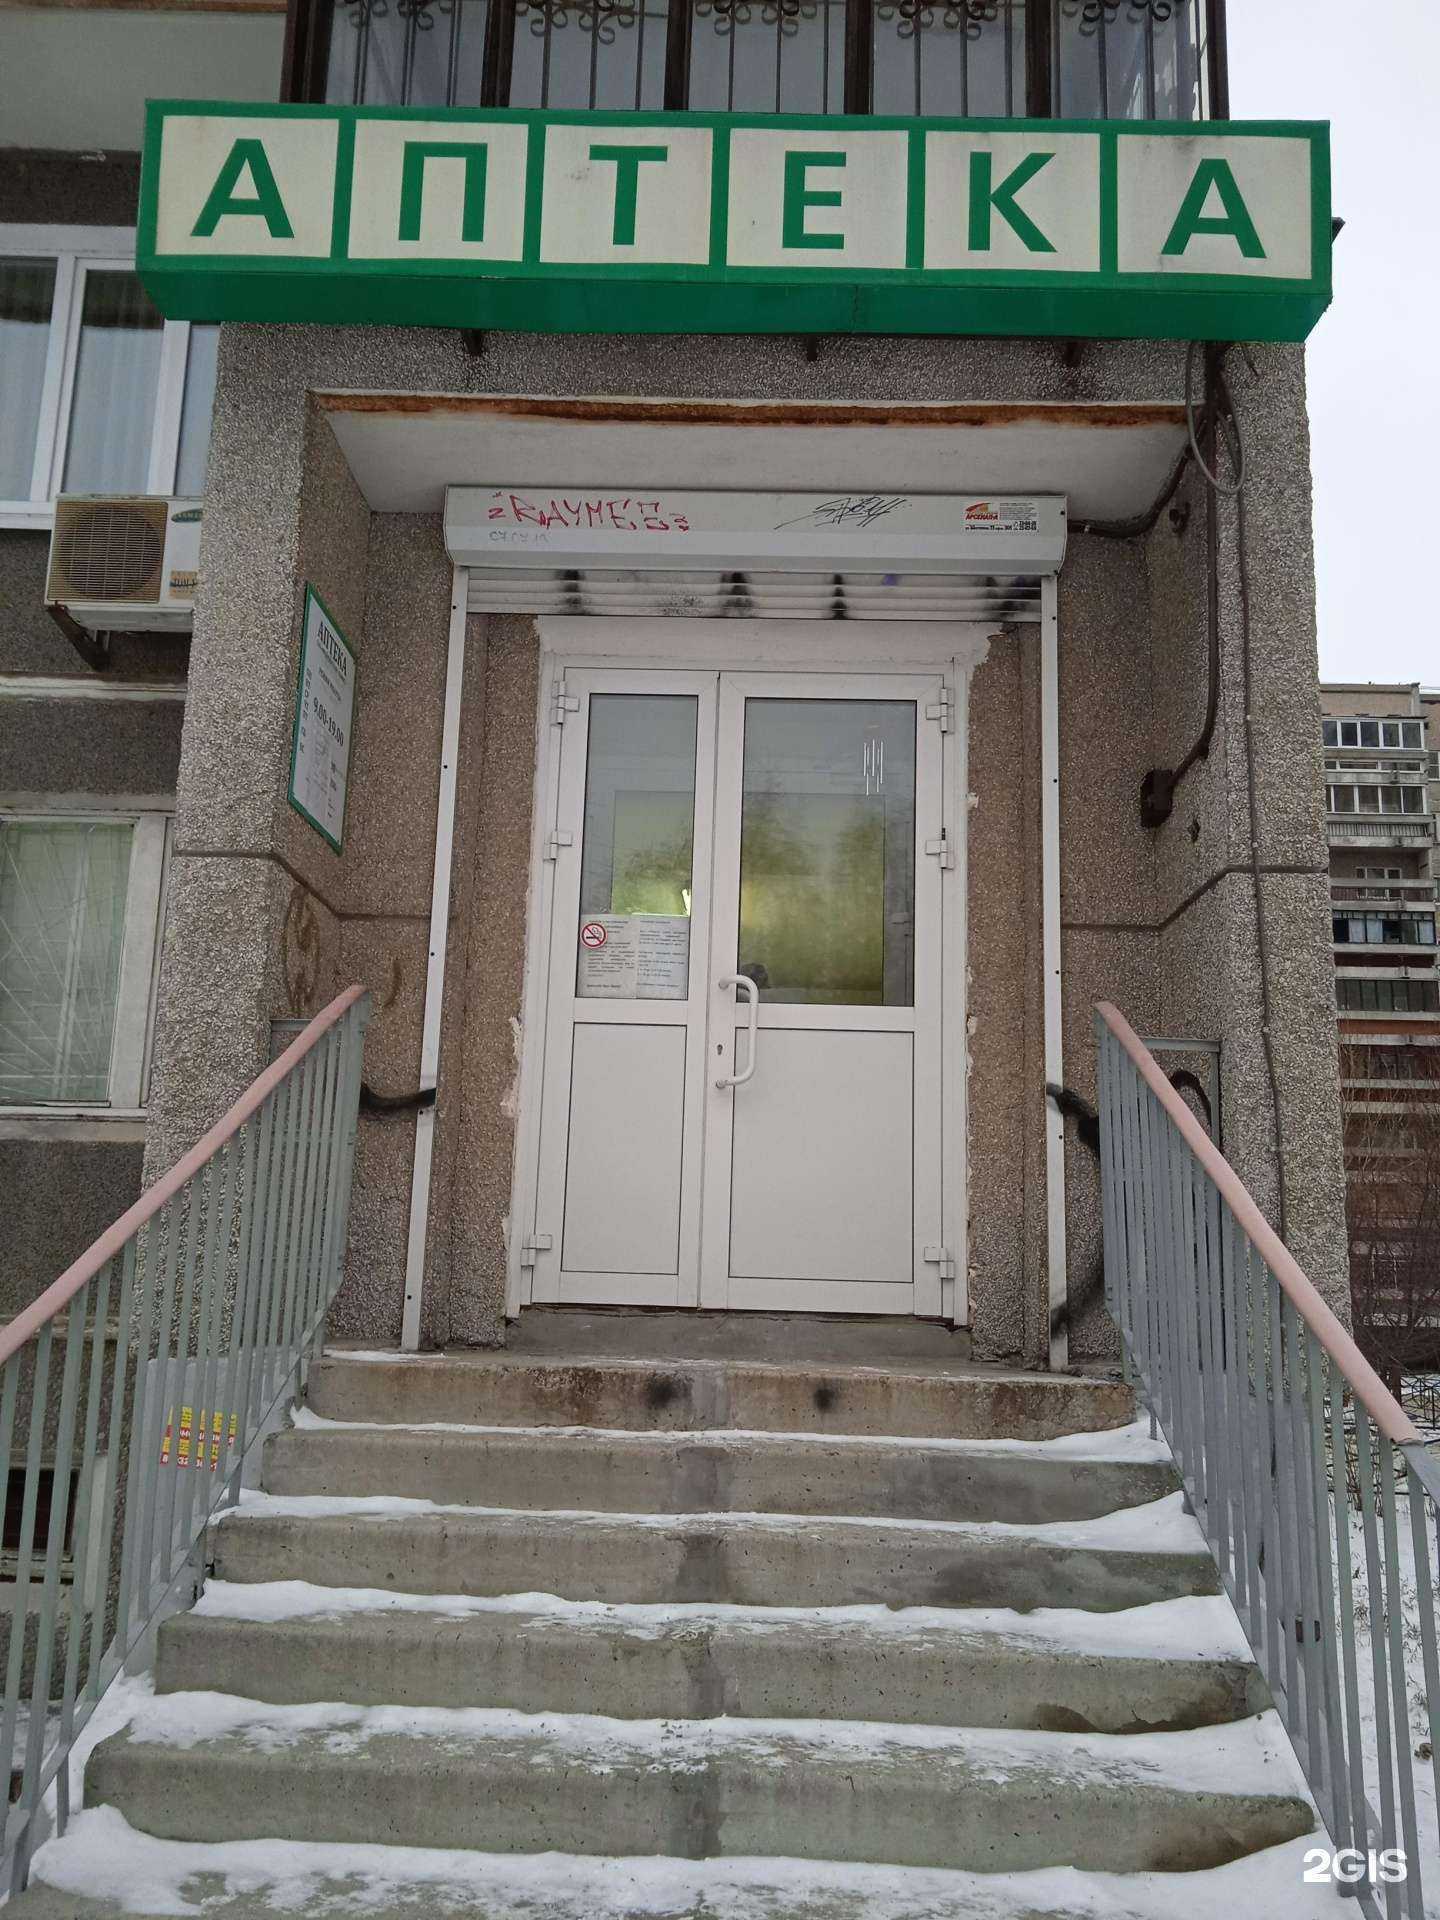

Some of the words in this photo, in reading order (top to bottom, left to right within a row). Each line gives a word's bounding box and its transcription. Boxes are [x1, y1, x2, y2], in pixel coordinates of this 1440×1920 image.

[190, 138, 1267, 258] АПТЕКА
[317, 620, 348, 677] АПТЕКА
[313, 696, 344, 747] 9.00-19.00
